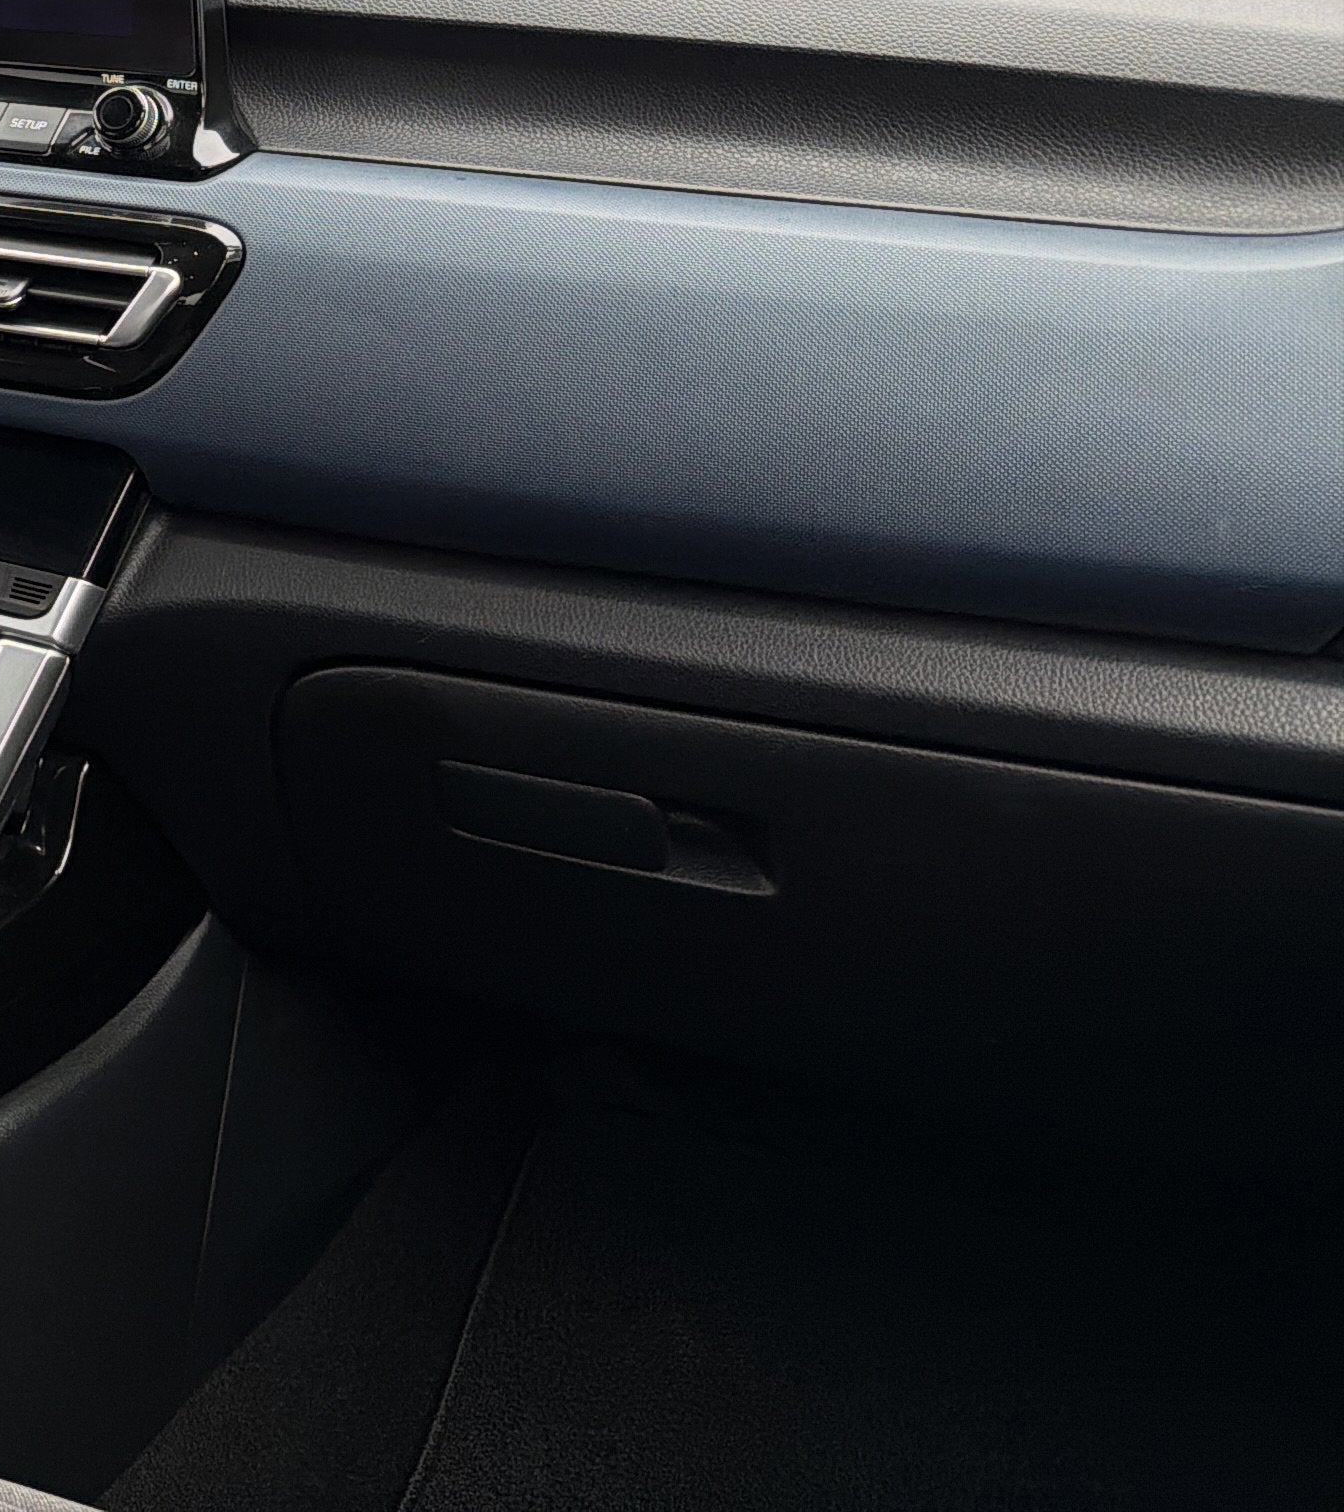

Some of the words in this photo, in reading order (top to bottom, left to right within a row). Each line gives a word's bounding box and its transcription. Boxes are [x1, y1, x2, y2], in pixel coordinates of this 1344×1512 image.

[101, 73, 125, 85] TUNE
[166, 78, 198, 90] ENTER
[8, 117, 49, 130] SETUP
[78, 145, 101, 156] FILE
